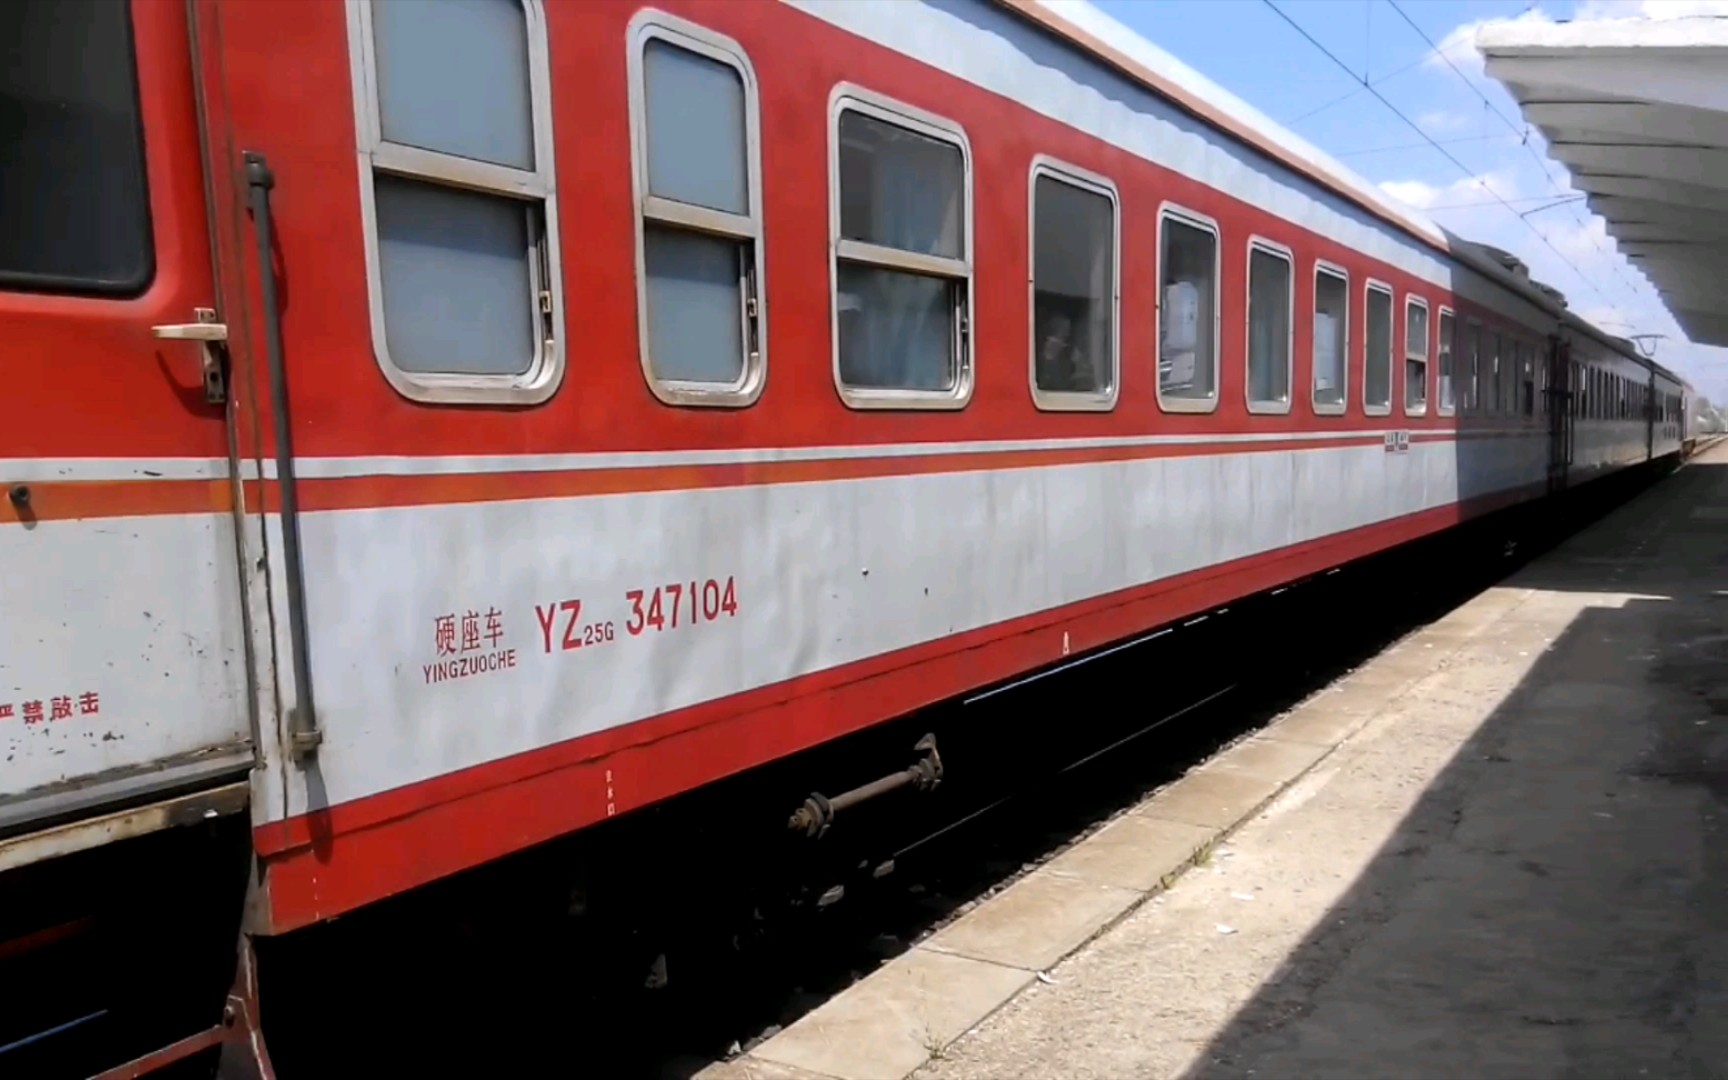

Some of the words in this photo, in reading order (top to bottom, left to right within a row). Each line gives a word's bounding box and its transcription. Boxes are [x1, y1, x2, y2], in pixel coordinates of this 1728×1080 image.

[626, 576, 738, 636] 347104
[434, 607, 505, 657] 硬座车
[423, 650, 516, 684] YINGZUOCHE
